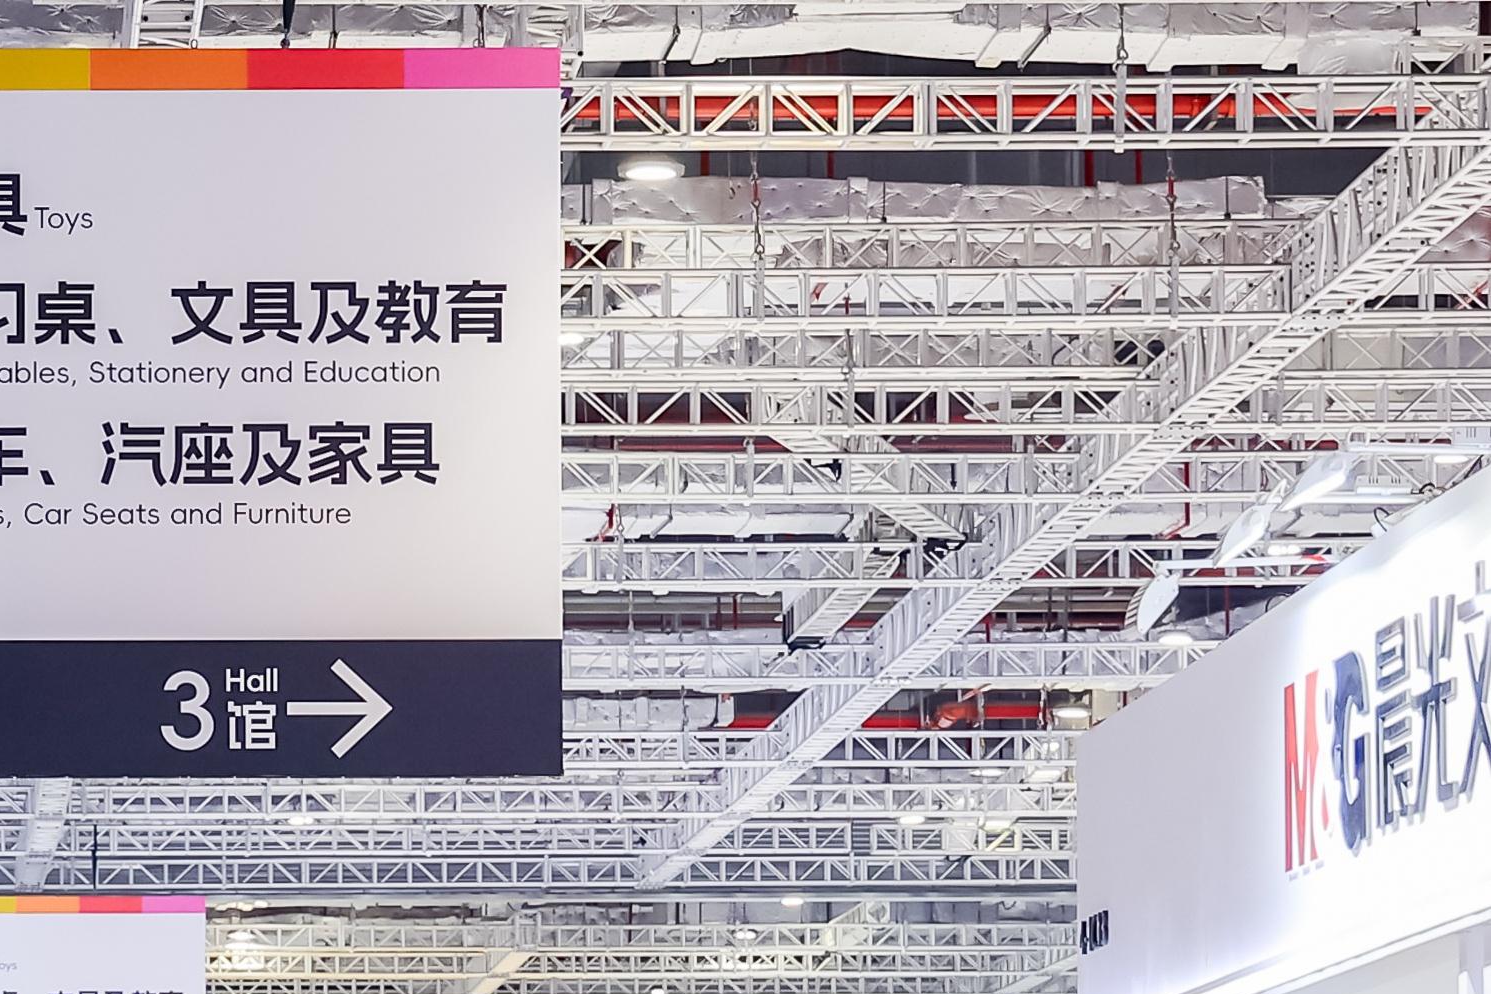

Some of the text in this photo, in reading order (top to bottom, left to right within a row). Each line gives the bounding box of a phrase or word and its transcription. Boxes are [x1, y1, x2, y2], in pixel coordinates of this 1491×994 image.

[34, 207, 93, 234] Toys
[89, 361, 231, 389] Stationery
[242, 361, 293, 383] and
[305, 361, 440, 383] Education
[24, 503, 72, 525] Car
[83, 503, 160, 525] Seats
[171, 503, 222, 525] and
[235, 502, 352, 525] Furniture
[226, 668, 277, 692] Hall
[161, 671, 214, 750] 3
[228, 701, 276, 750] 馆
[1284, 651, 1370, 874] MG
